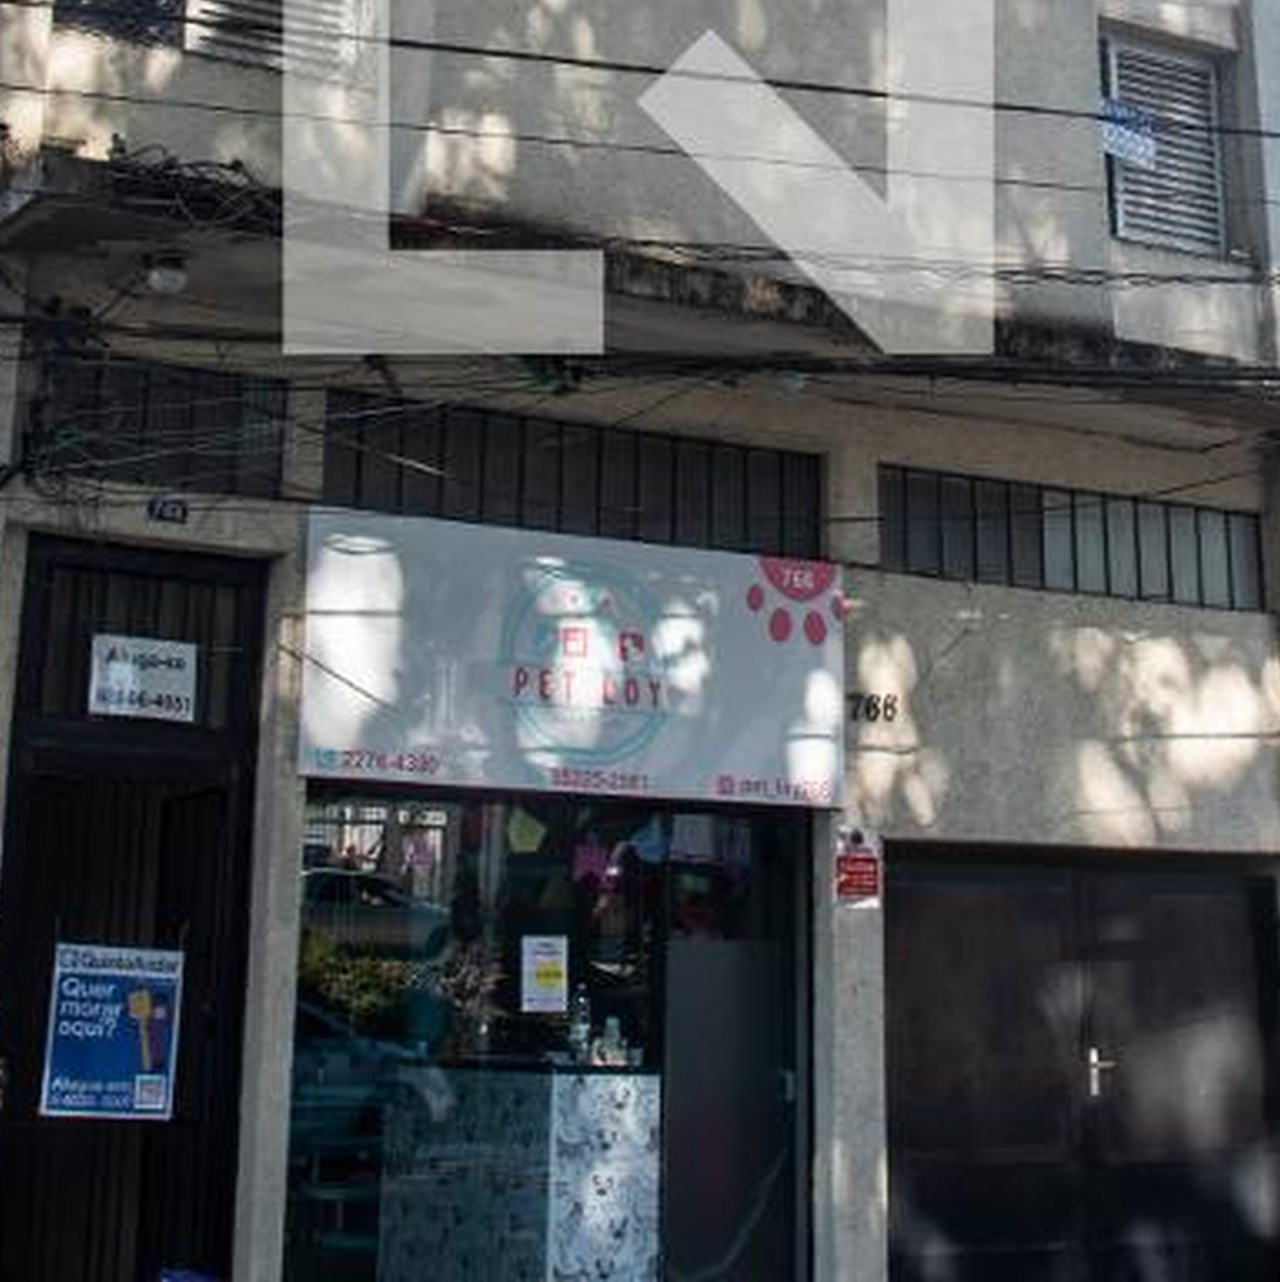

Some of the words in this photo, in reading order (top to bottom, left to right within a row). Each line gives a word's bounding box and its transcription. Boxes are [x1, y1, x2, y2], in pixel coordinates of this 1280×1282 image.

[513, 666, 575, 701] PET
[602, 676, 662, 709] LOY
[61, 977, 118, 1001] Quer
[58, 1000, 123, 1018] morar
[58, 1016, 118, 1040] aqui?
